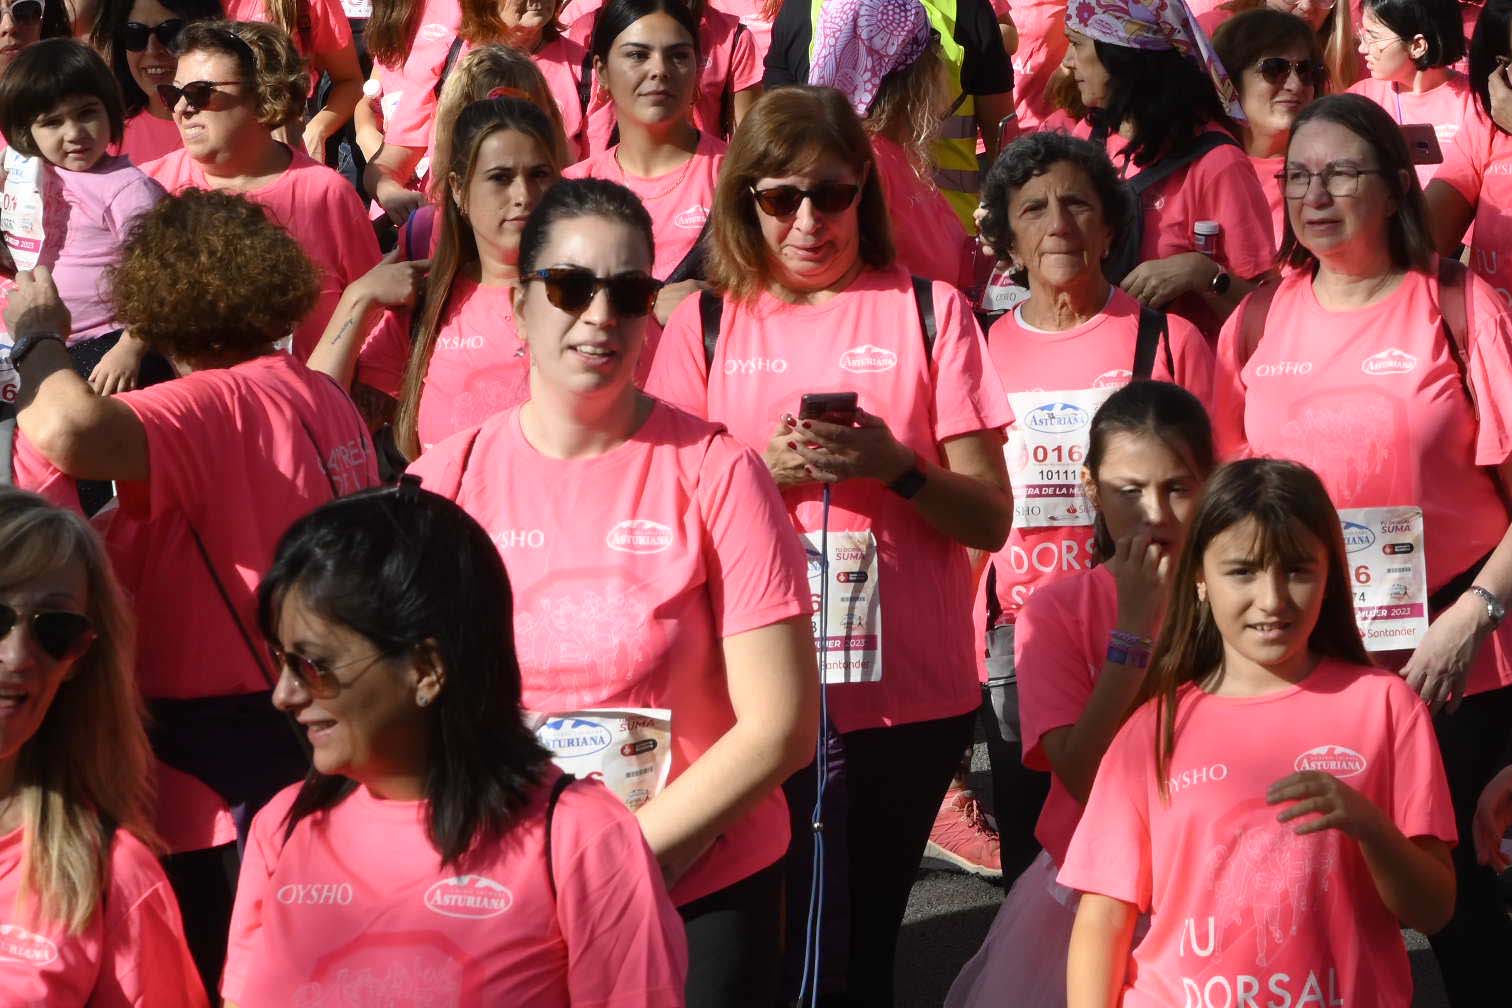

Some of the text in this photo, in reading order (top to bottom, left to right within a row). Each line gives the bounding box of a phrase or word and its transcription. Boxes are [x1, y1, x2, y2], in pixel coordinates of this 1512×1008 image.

[1033, 445, 1083, 464] 016
[1039, 470, 1077, 482] 10111
[1041, 487, 1055, 497] DE
[1056, 487, 1068, 496] LA
[1381, 524, 1411, 535] SUMA
[1389, 607, 1411, 617] 2023
[1367, 627, 1416, 640] Santander
[1300, 757, 1361, 771] ASTURIANA
[276, 882, 353, 906] OYSHO
[430, 888, 508, 911] ASTURIANA
